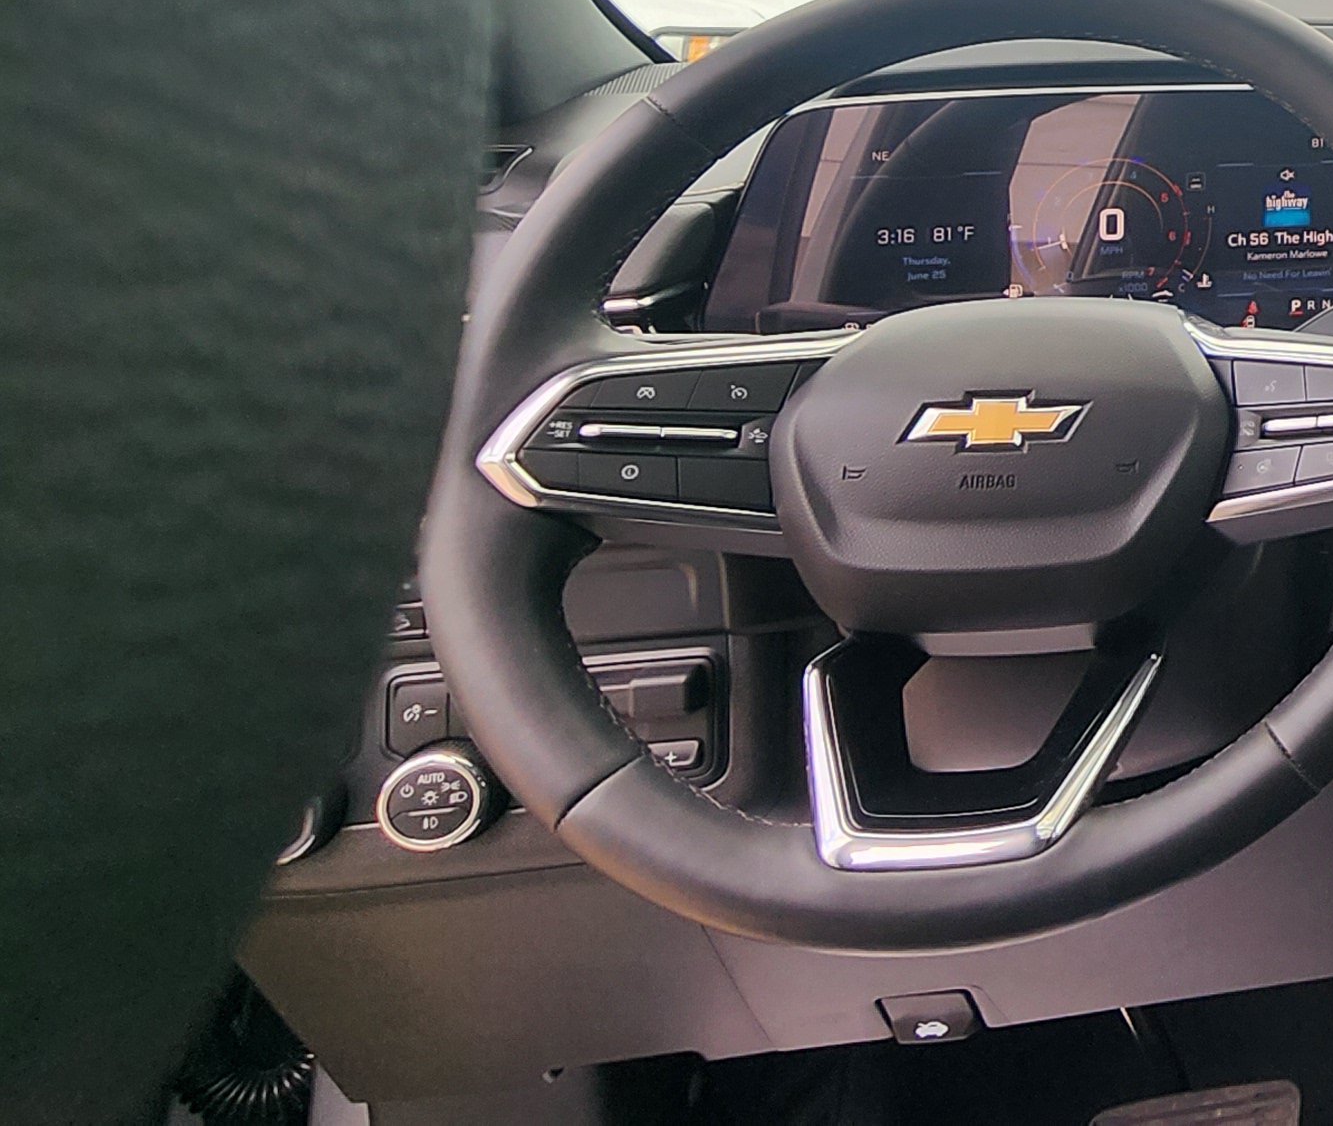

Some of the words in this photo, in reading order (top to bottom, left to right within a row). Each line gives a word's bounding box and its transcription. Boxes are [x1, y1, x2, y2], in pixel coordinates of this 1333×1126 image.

[872, 152, 890, 162] NE
[1266, 195, 1309, 211] highway
[1207, 206, 1215, 215] H
[1099, 208, 1125, 241] 0
[878, 229, 915, 244] 3:16
[1228, 233, 1246, 247] Ch
[1250, 233, 1269, 246] 56
[1274, 232, 1300, 245] The
[1100, 245, 1124, 255] MPH
[1246, 251, 1288, 261] Kameron
[1290, 249, 1329, 260] Marlowe
[908, 271, 928, 282] June
[1121, 270, 1145, 279] RPM
[1243, 271, 1257, 281] No
[1260, 270, 1283, 279] Need
[1286, 269, 1300, 279] For
[1291, 300, 1302, 313] P
[1307, 300, 1316, 311] R
[1322, 299, 1331, 310] N
[959, 474, 1016, 490] AIRBAG
[418, 772, 446, 785] AUTO
